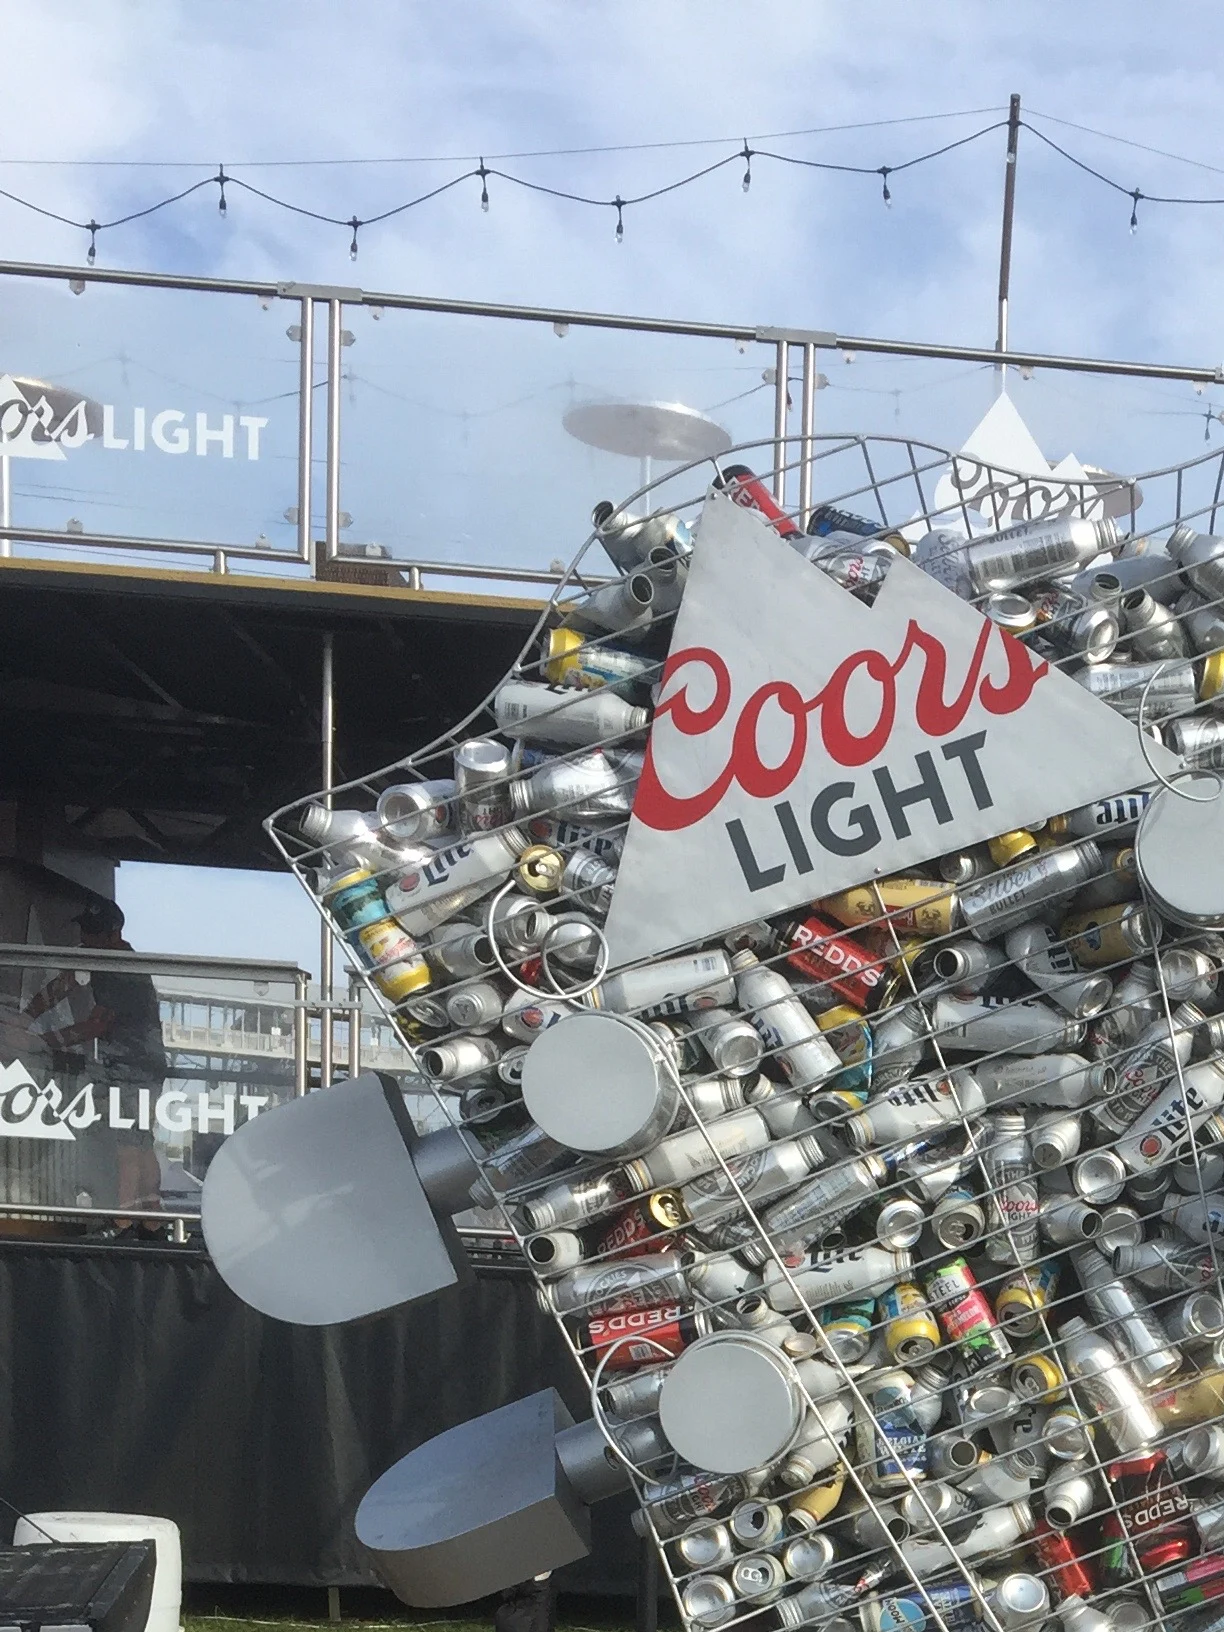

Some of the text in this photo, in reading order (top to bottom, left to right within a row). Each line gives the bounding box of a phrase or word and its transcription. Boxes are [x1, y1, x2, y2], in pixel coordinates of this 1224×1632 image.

[0, 396, 270, 461] ors LIGHT
[631, 617, 1049, 832] Coors
[725, 730, 995, 893] LIGHT
[792, 923, 882, 988] REDD'S
[0, 1078, 270, 1136] ors LIGHT
[588, 1305, 682, 1335] REDD'S
